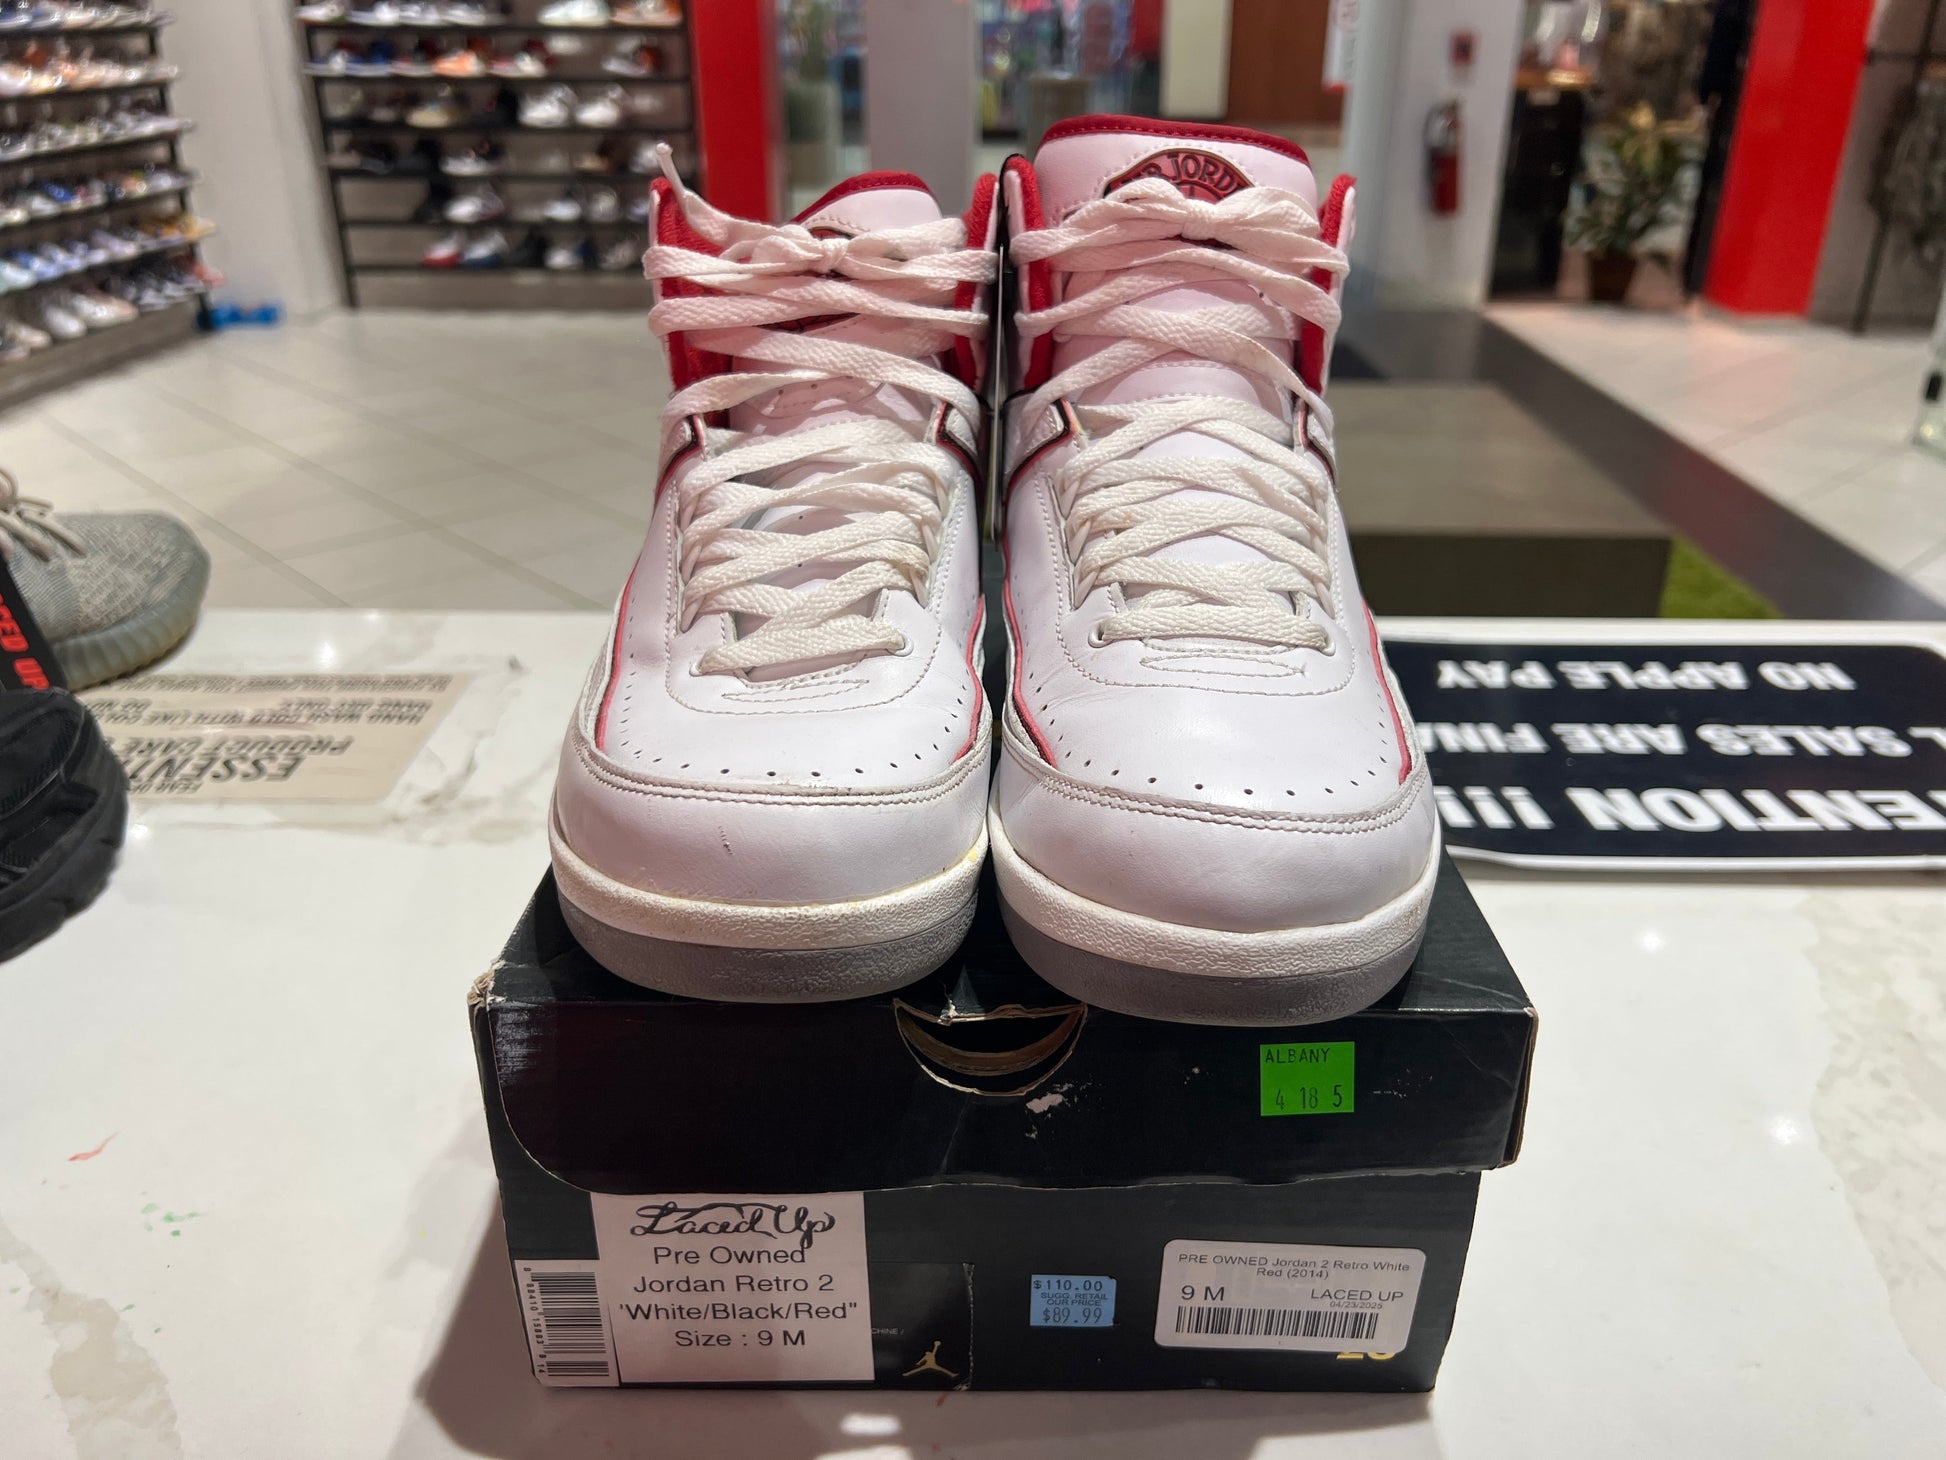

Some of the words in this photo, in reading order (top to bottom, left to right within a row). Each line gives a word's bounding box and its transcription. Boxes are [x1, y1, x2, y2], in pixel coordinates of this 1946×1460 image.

[13, 657, 50, 690] UP
[1437, 660, 1558, 689] PAY
[1557, 660, 1750, 690] APPLE
[1757, 661, 1858, 690] NO
[118, 737, 204, 757] CARE
[202, 736, 354, 755] PRODUCT
[1549, 723, 1688, 755] ARE
[1696, 723, 1913, 757] SALES
[1265, 1047, 1331, 1064] ALBANY
[1275, 1088, 1286, 1110] 4
[1299, 1086, 1319, 1110] 18
[1331, 1084, 1344, 1108] 5
[630, 1201, 778, 1240] Laced
[772, 1204, 836, 1250] Up
[653, 1246, 700, 1264] Pre
[710, 1246, 806, 1264] Owned
[1179, 1254, 1209, 1264] PRE
[1212, 1255, 1269, 1266] OWNED
[1271, 1258, 1317, 1269] Jordan
[1321, 1260, 1330, 1270] 2
[1333, 1260, 1369, 1271] Retro
[1373, 1261, 1411, 1272] White
[633, 1276, 725, 1293] Jordan
[736, 1275, 808, 1292] Retro
[818, 1274, 834, 1291] 2
[1256, 1268, 1283, 1277] Red
[1286, 1268, 1330, 1280] (2014)
[1033, 1279, 1103, 1291] $110.00
[1181, 1285, 1195, 1301] 9
[1204, 1286, 1225, 1302] M
[1310, 1288, 1373, 1301] LACED
[1378, 1291, 1405, 1302] UP
[1071, 1299, 1101, 1307] PRICE
[1074, 1293, 1109, 1301] RETAIL
[1042, 1307, 1102, 1324] $89.99
[675, 1330, 732, 1347] Size
[757, 1330, 773, 1346] 9
[783, 1330, 806, 1346] M
